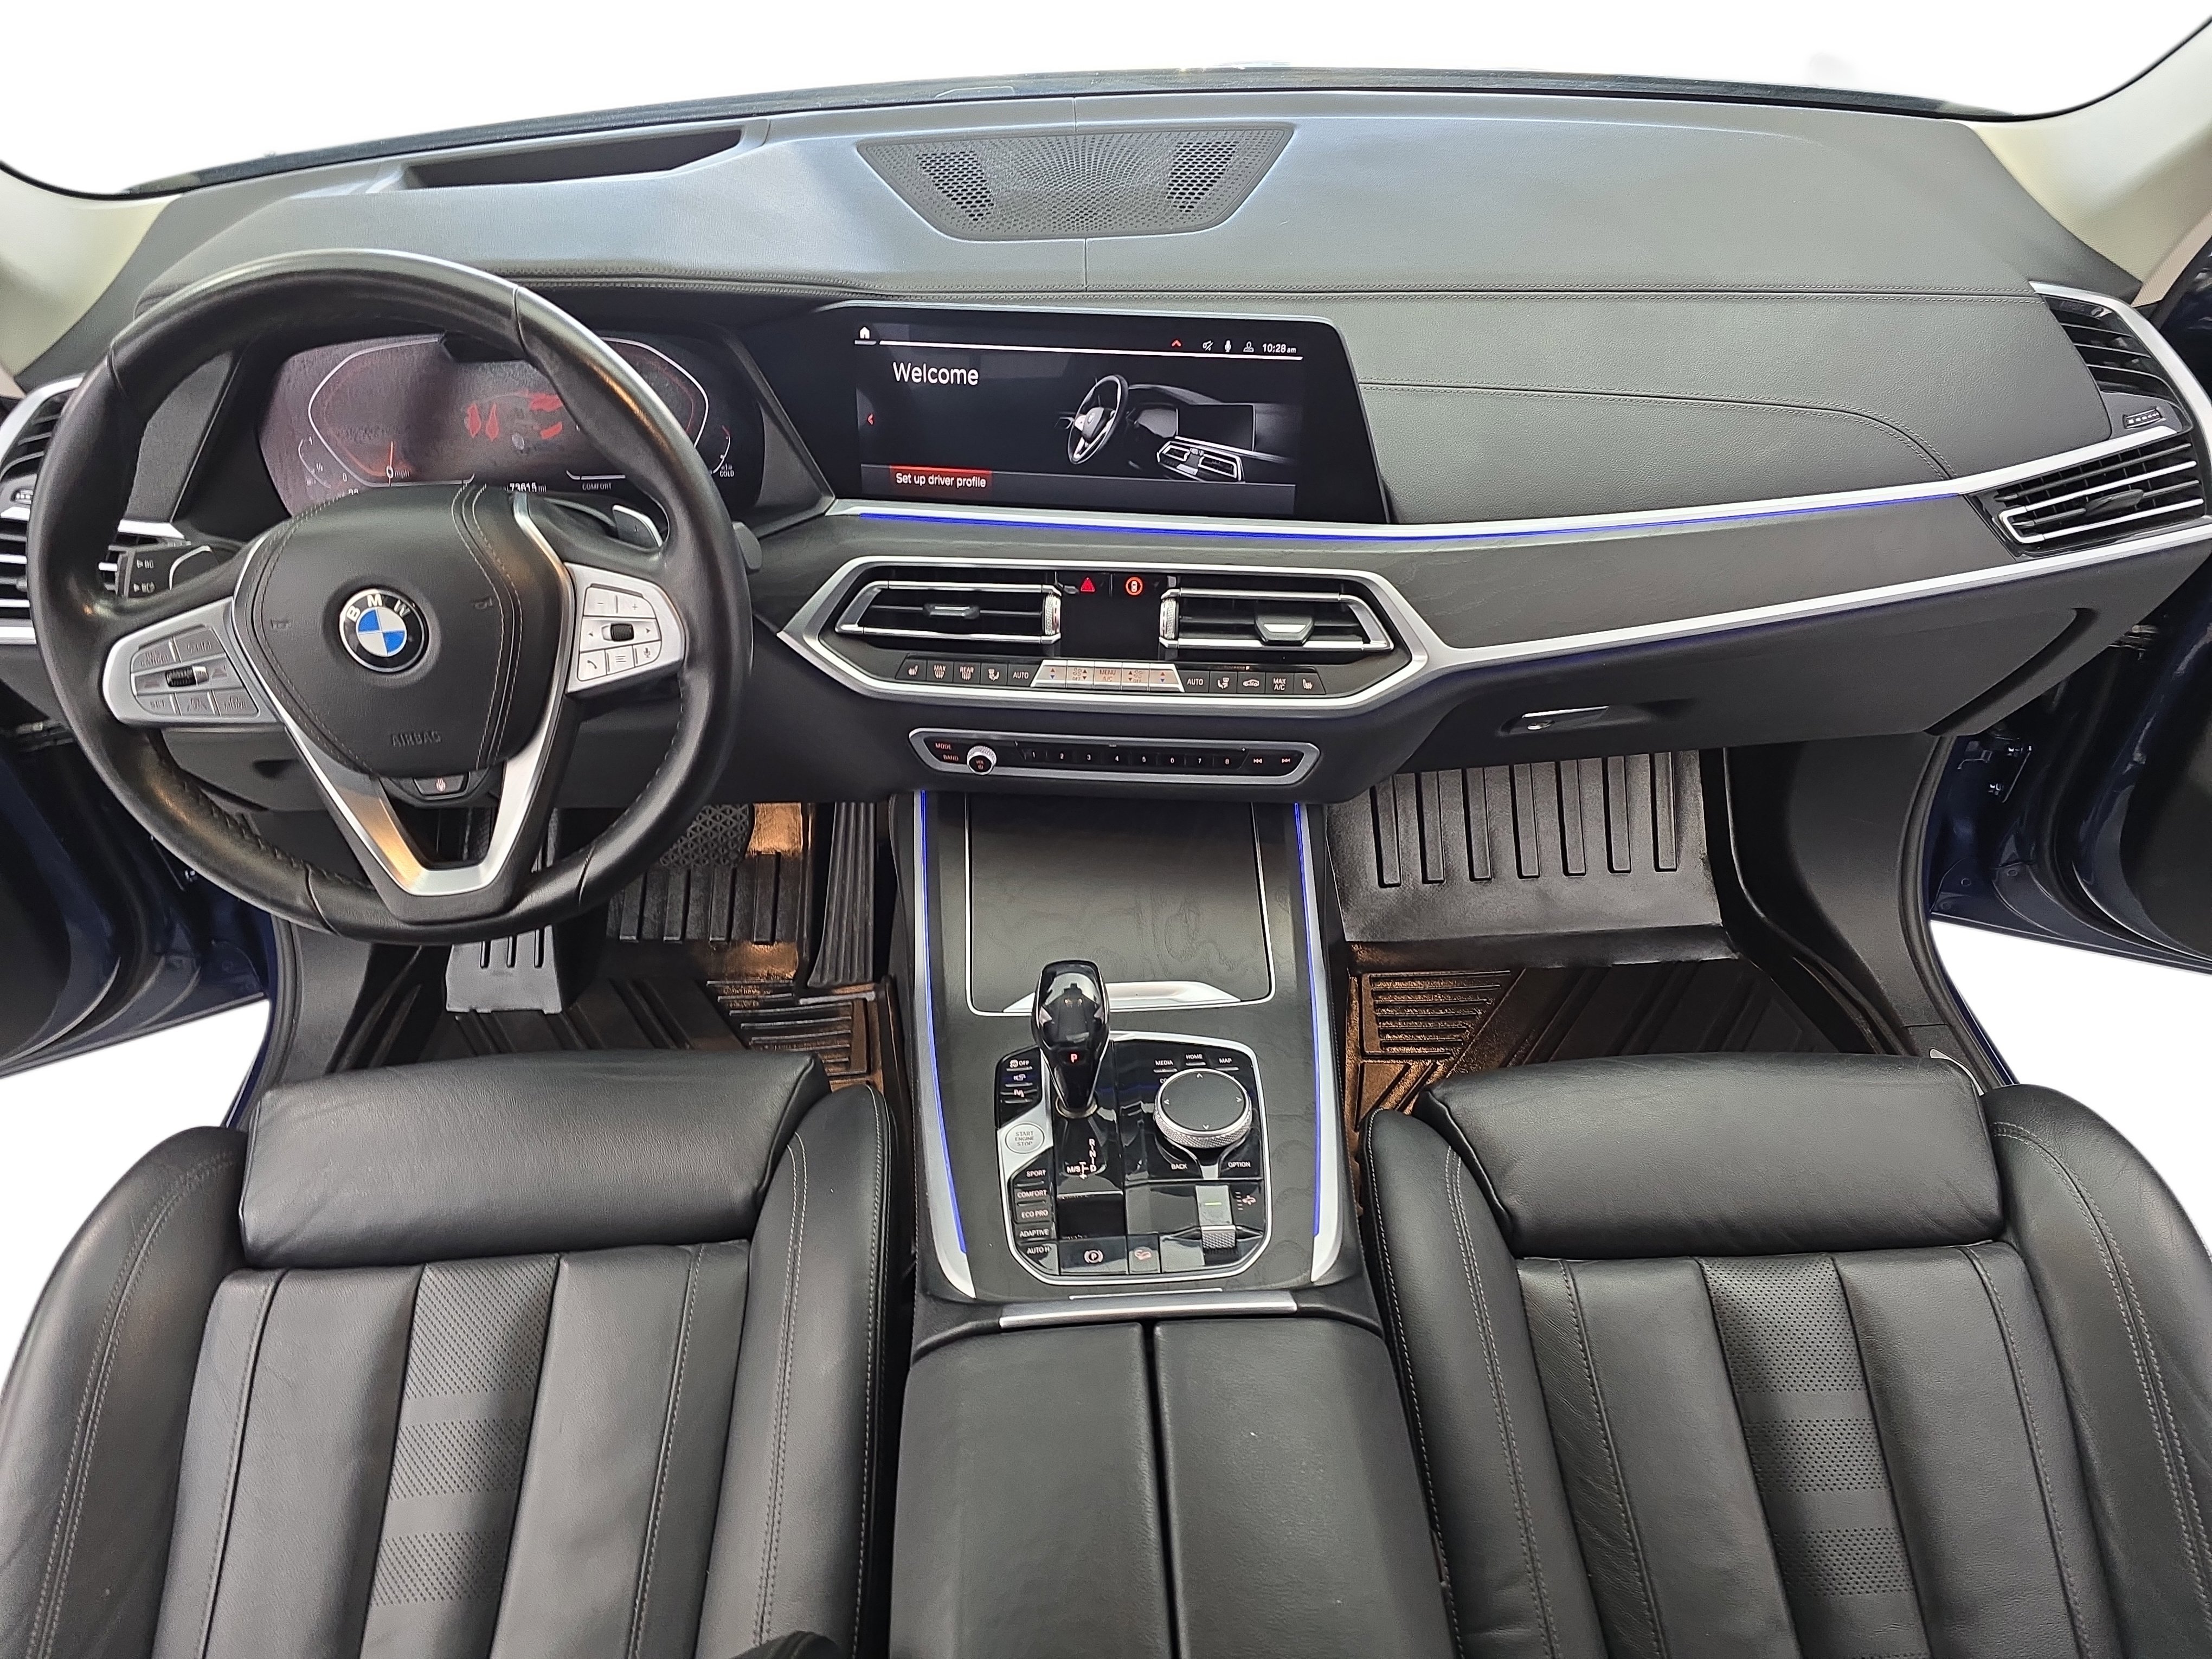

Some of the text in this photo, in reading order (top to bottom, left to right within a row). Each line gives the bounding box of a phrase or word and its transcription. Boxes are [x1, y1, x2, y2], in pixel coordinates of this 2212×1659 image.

[1262, 343, 1287, 353] 10:28
[892, 362, 979, 385] Welcome
[896, 472, 986, 488] Set up driver profile
[582, 483, 612, 491] COMFORT
[346, 594, 411, 623] BMW
[1012, 671, 1030, 679] AUTO
[1187, 678, 1204, 686] AUTO
[392, 730, 441, 748] AIRBAG
[935, 742, 952, 750] MODE
[1070, 1053, 1078, 1063] P
[1089, 1139, 1096, 1147] R
[1089, 1150, 1097, 1158] N
[1026, 1169, 1047, 1178] SPORT
[1017, 1189, 1047, 1199] COMFORT
[1021, 1209, 1049, 1219] ECO PRO
[1019, 1228, 1050, 1238] ADAPTIVE
[1026, 1246, 1045, 1255] AUTO
